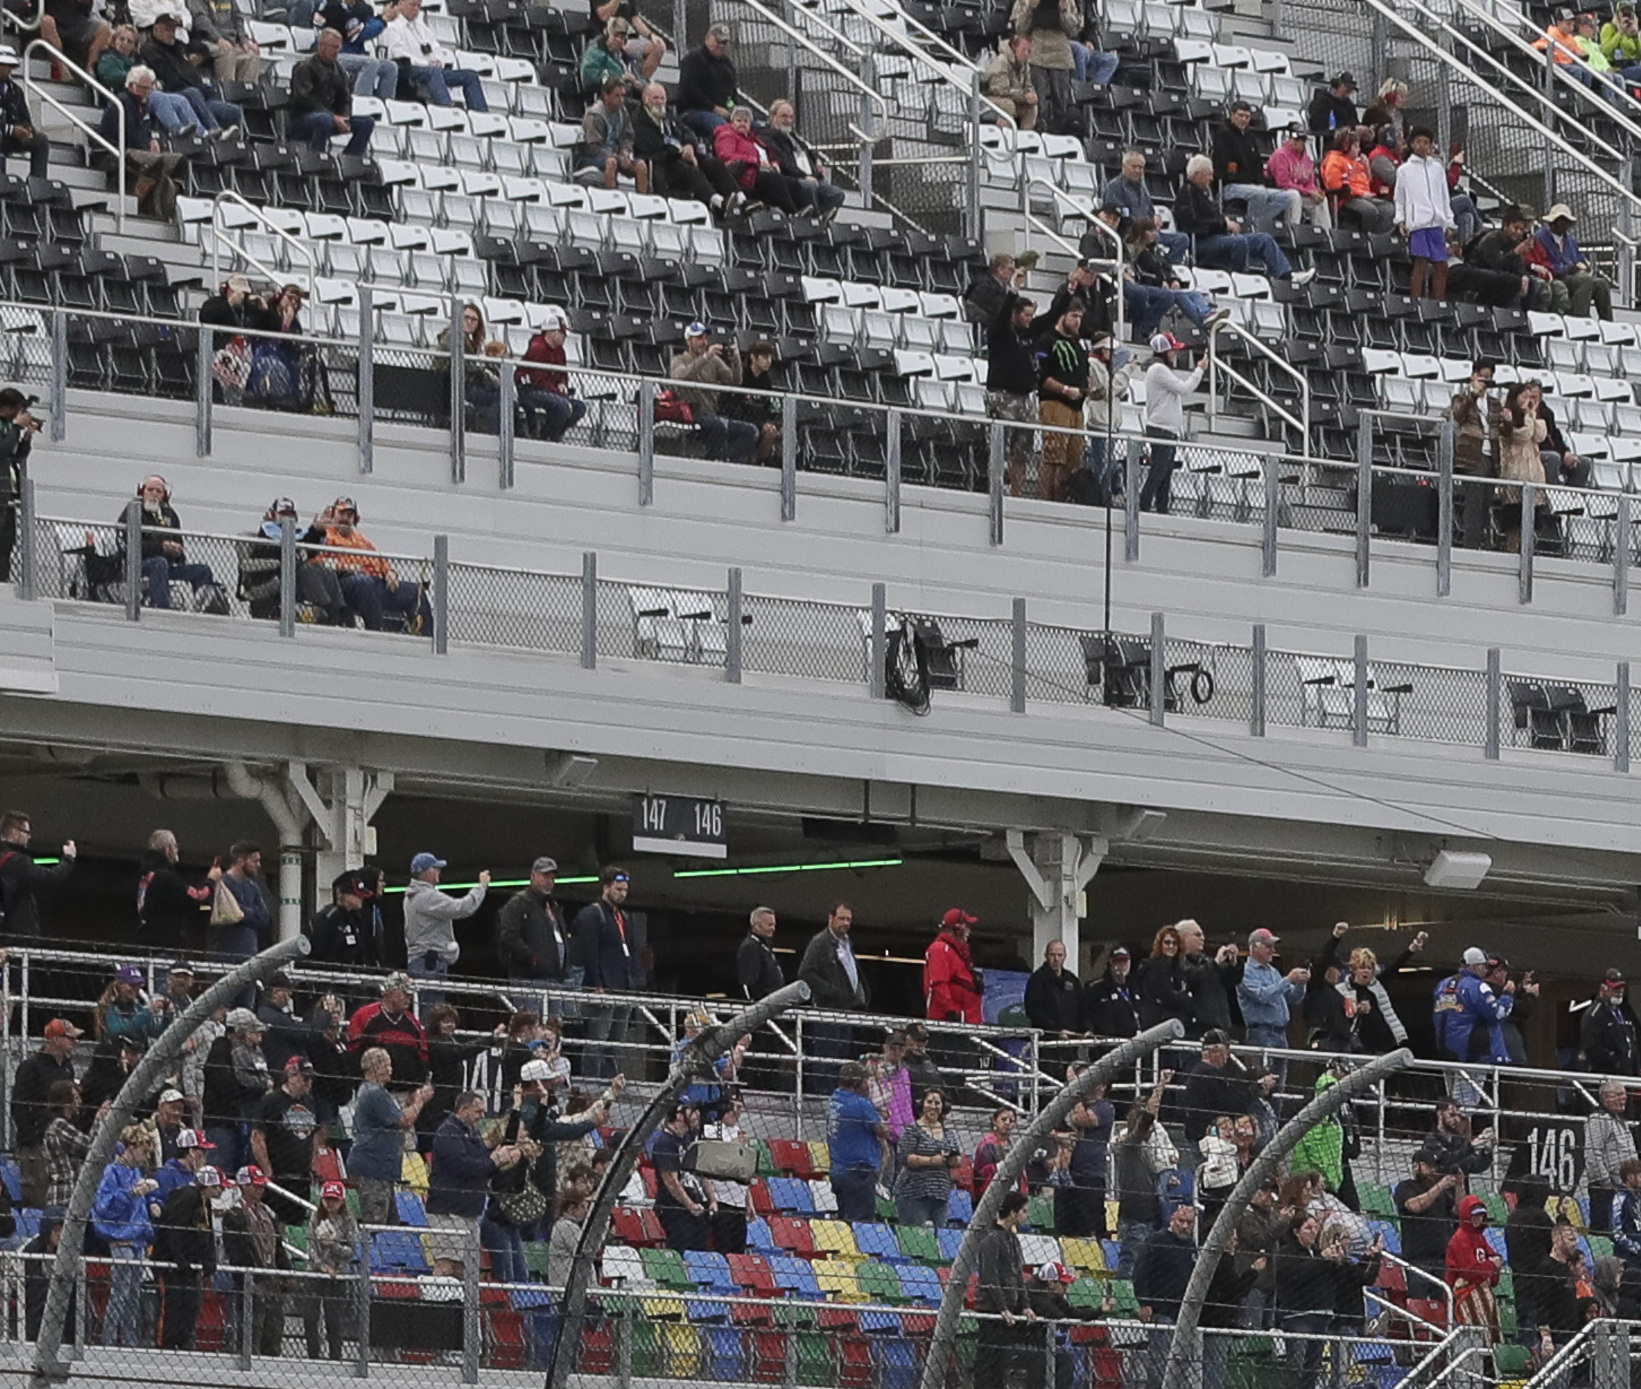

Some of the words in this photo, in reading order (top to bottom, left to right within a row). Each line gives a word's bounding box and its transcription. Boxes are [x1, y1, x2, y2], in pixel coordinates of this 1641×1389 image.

[641, 798, 667, 831] 147
[694, 803, 722, 836] 146
[1527, 1127, 1576, 1192] 146
